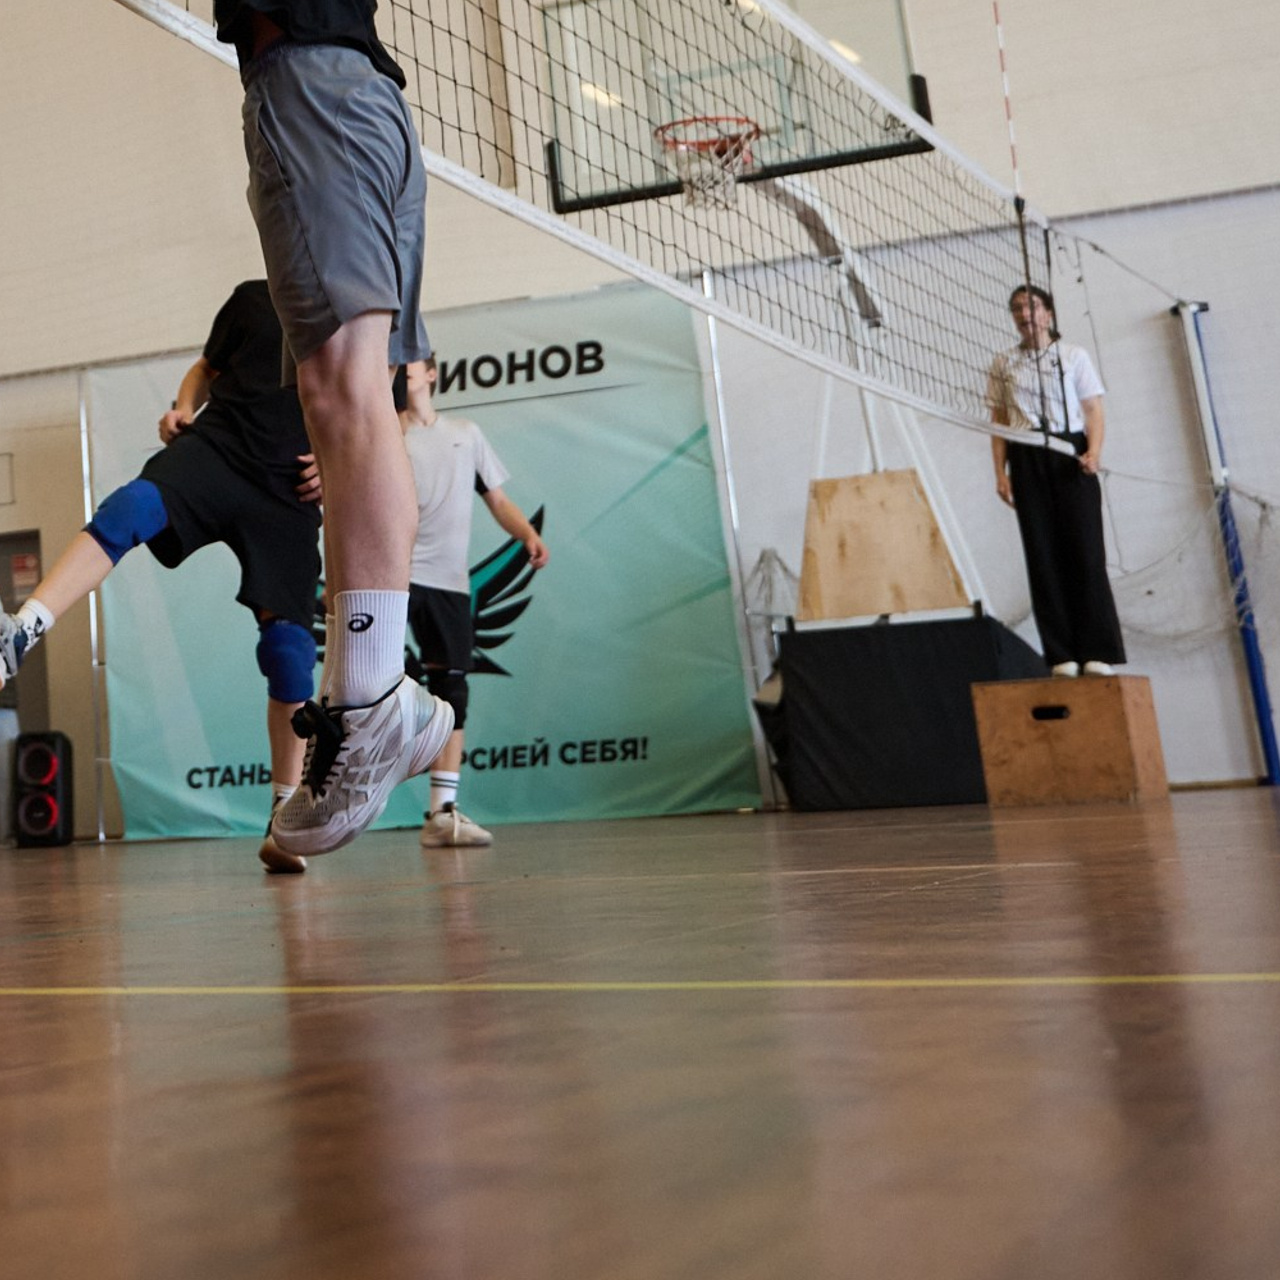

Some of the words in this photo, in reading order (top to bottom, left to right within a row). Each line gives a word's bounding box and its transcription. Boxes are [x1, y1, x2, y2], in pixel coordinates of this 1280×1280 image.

[186, 763, 272, 789] СТАНЬ
[461, 737, 549, 770] СИЕЙ
[559, 736, 649, 765] СЕБЯ!
